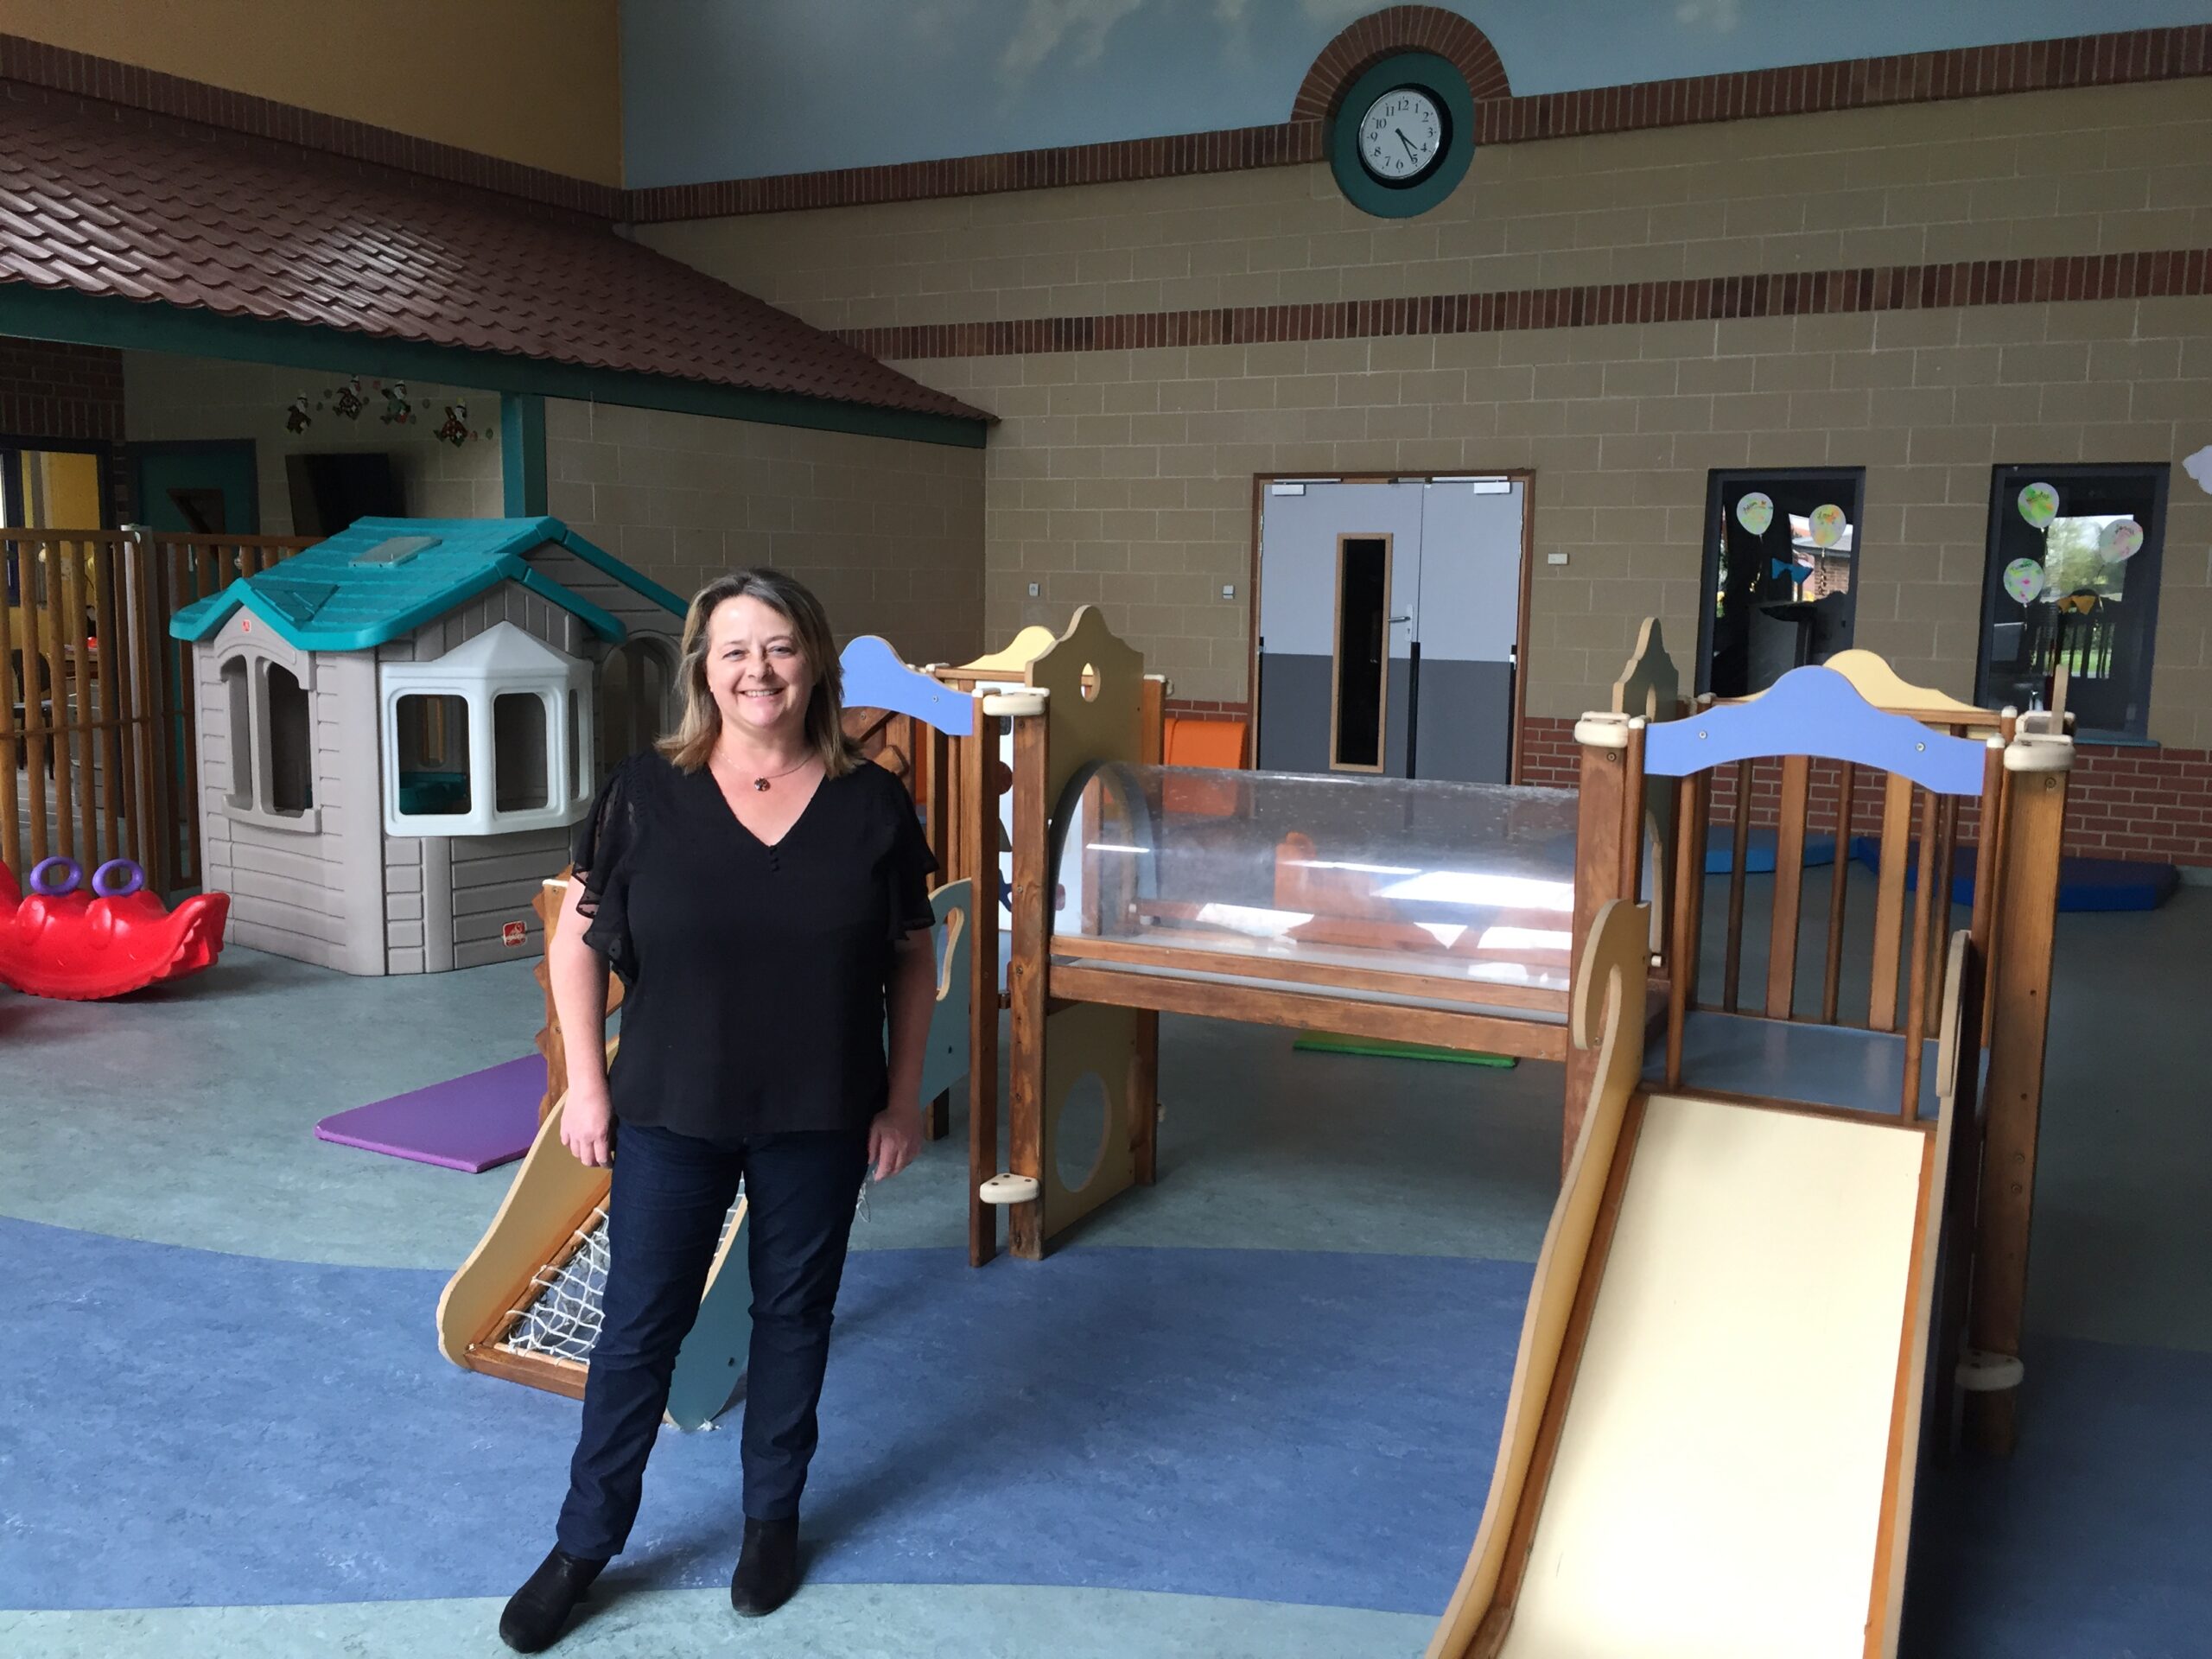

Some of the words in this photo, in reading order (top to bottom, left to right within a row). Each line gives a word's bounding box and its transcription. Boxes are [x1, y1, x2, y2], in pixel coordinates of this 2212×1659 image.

[1397, 99, 1409, 111] 12
[1414, 103, 1419, 114] 1
[1385, 105, 1395, 117] 11
[1421, 111, 1429, 123] 2
[1376, 118, 1387, 130] 10
[1370, 131, 1378, 143] 9
[1427, 127, 1433, 137] 3
[1374, 147, 1382, 157] 8
[1420, 142, 1427, 152] 4
[1384, 156, 1391, 167] 7
[1395, 159, 1404, 169] 6
[1411, 154, 1419, 165] 5
